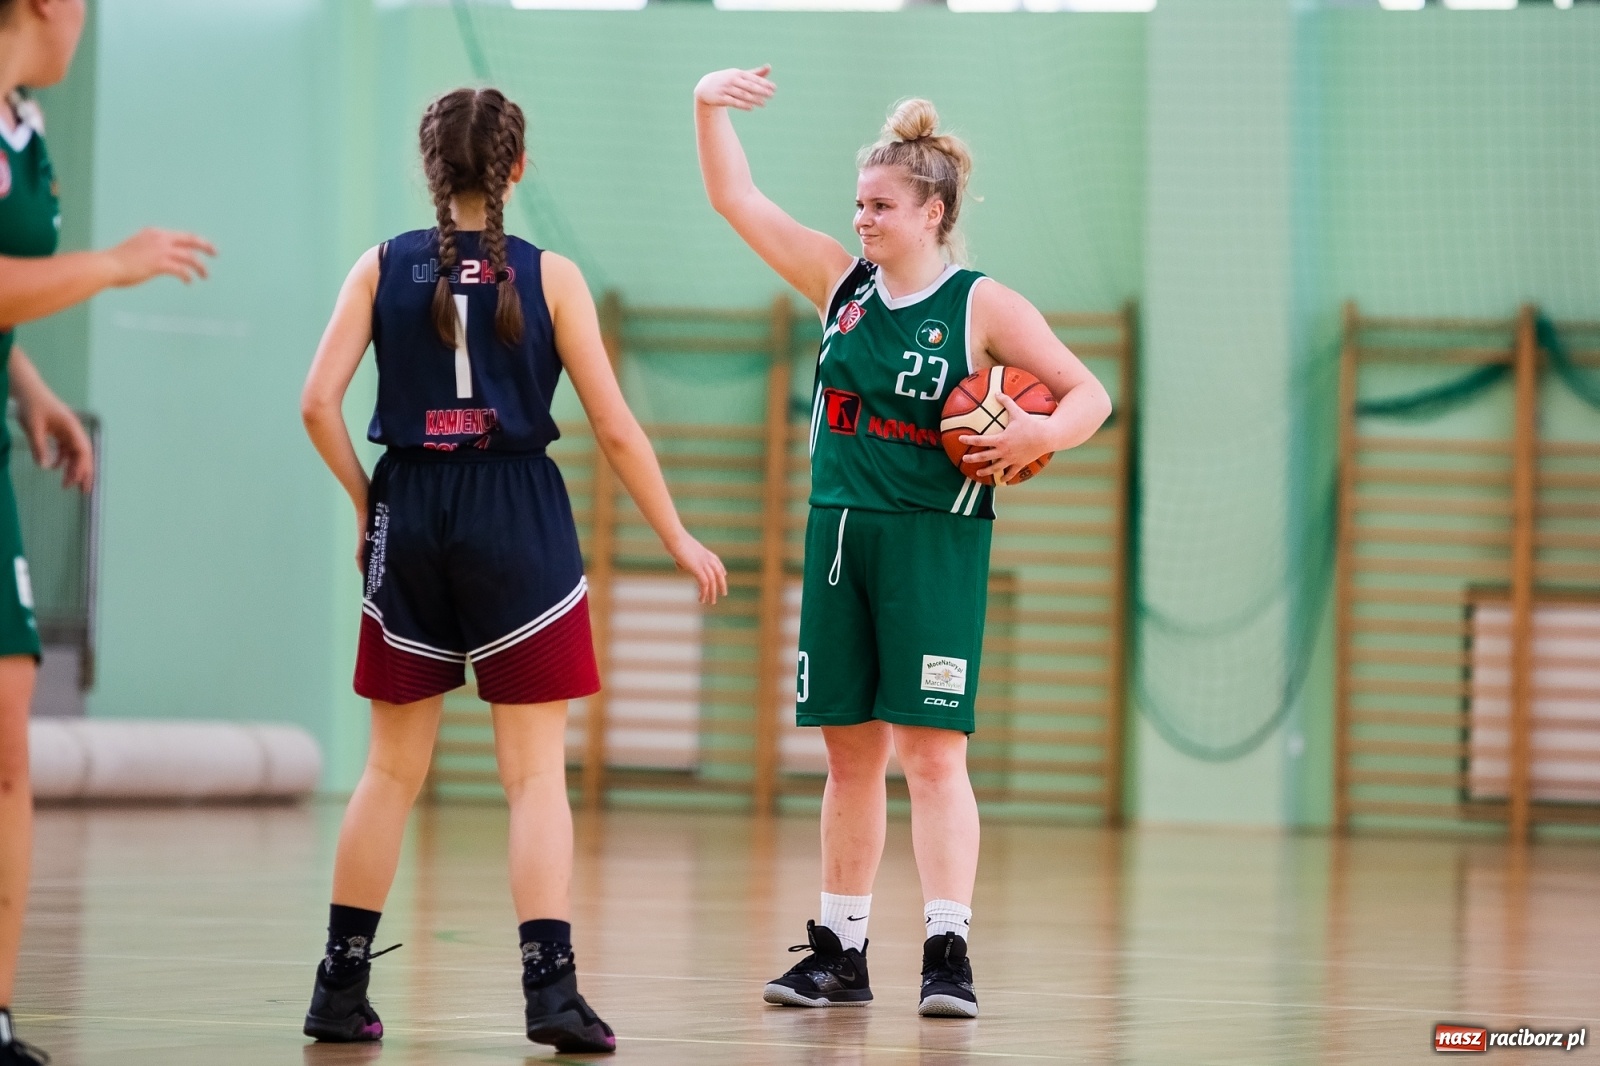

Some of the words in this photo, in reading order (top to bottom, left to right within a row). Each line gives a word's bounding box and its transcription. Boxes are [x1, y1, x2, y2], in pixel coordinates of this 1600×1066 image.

[452, 294, 473, 399] 1
[894, 350, 949, 401] 23
[797, 651, 809, 703] 3
[923, 697, 959, 708] COLO
